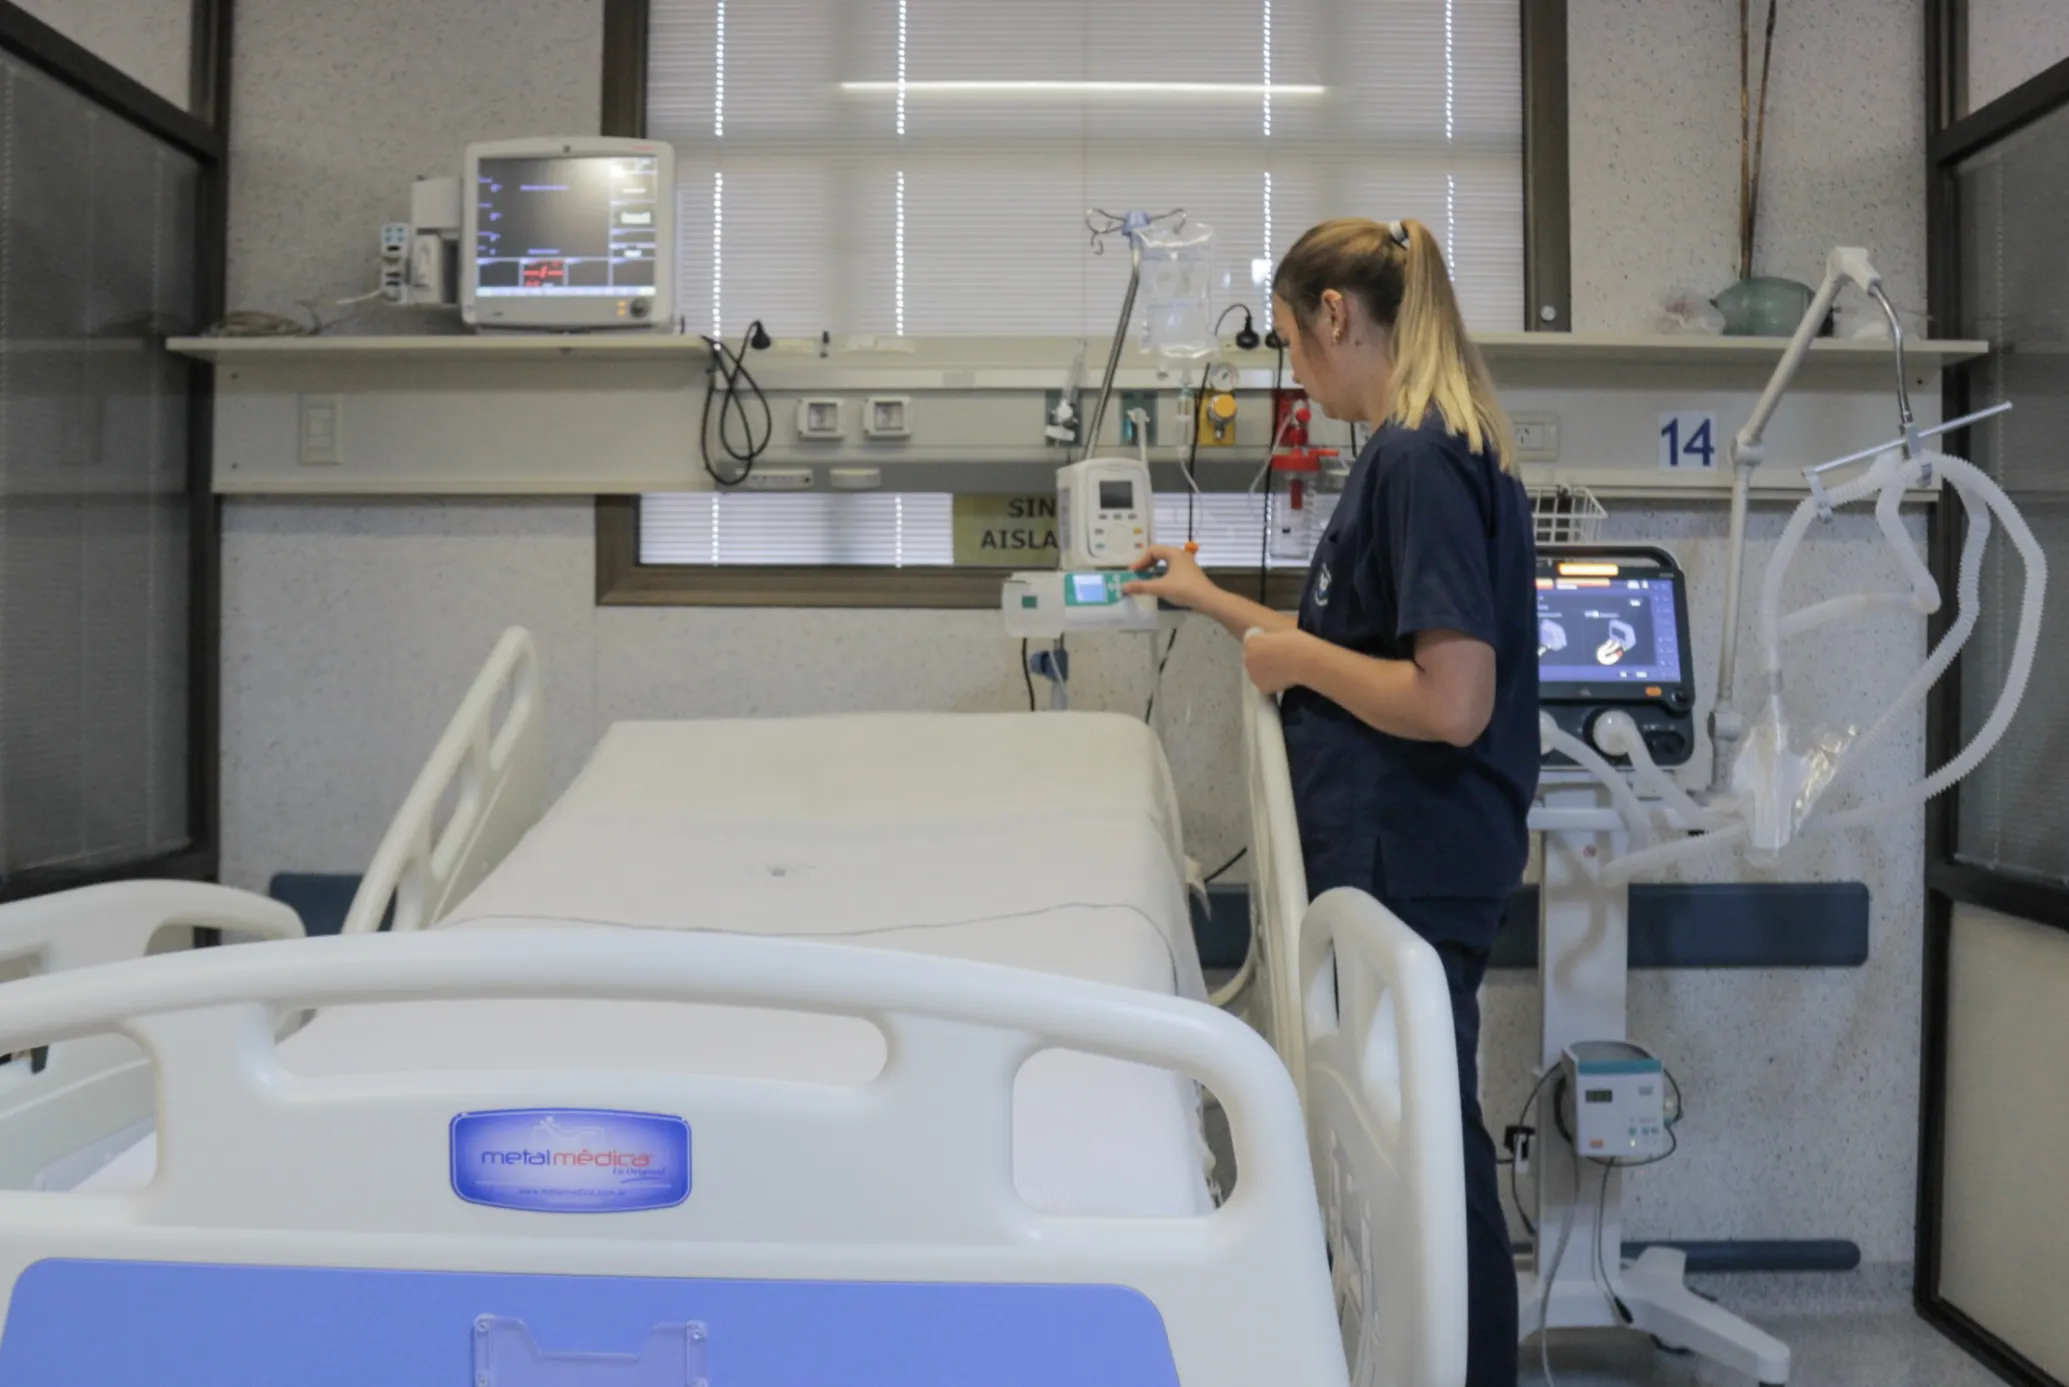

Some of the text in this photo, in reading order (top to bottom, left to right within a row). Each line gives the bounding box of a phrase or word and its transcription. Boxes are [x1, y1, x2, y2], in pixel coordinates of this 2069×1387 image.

[1660, 416, 1716, 467] 14
[1007, 497, 1057, 518] SIN
[981, 529, 1059, 550] AISLA
